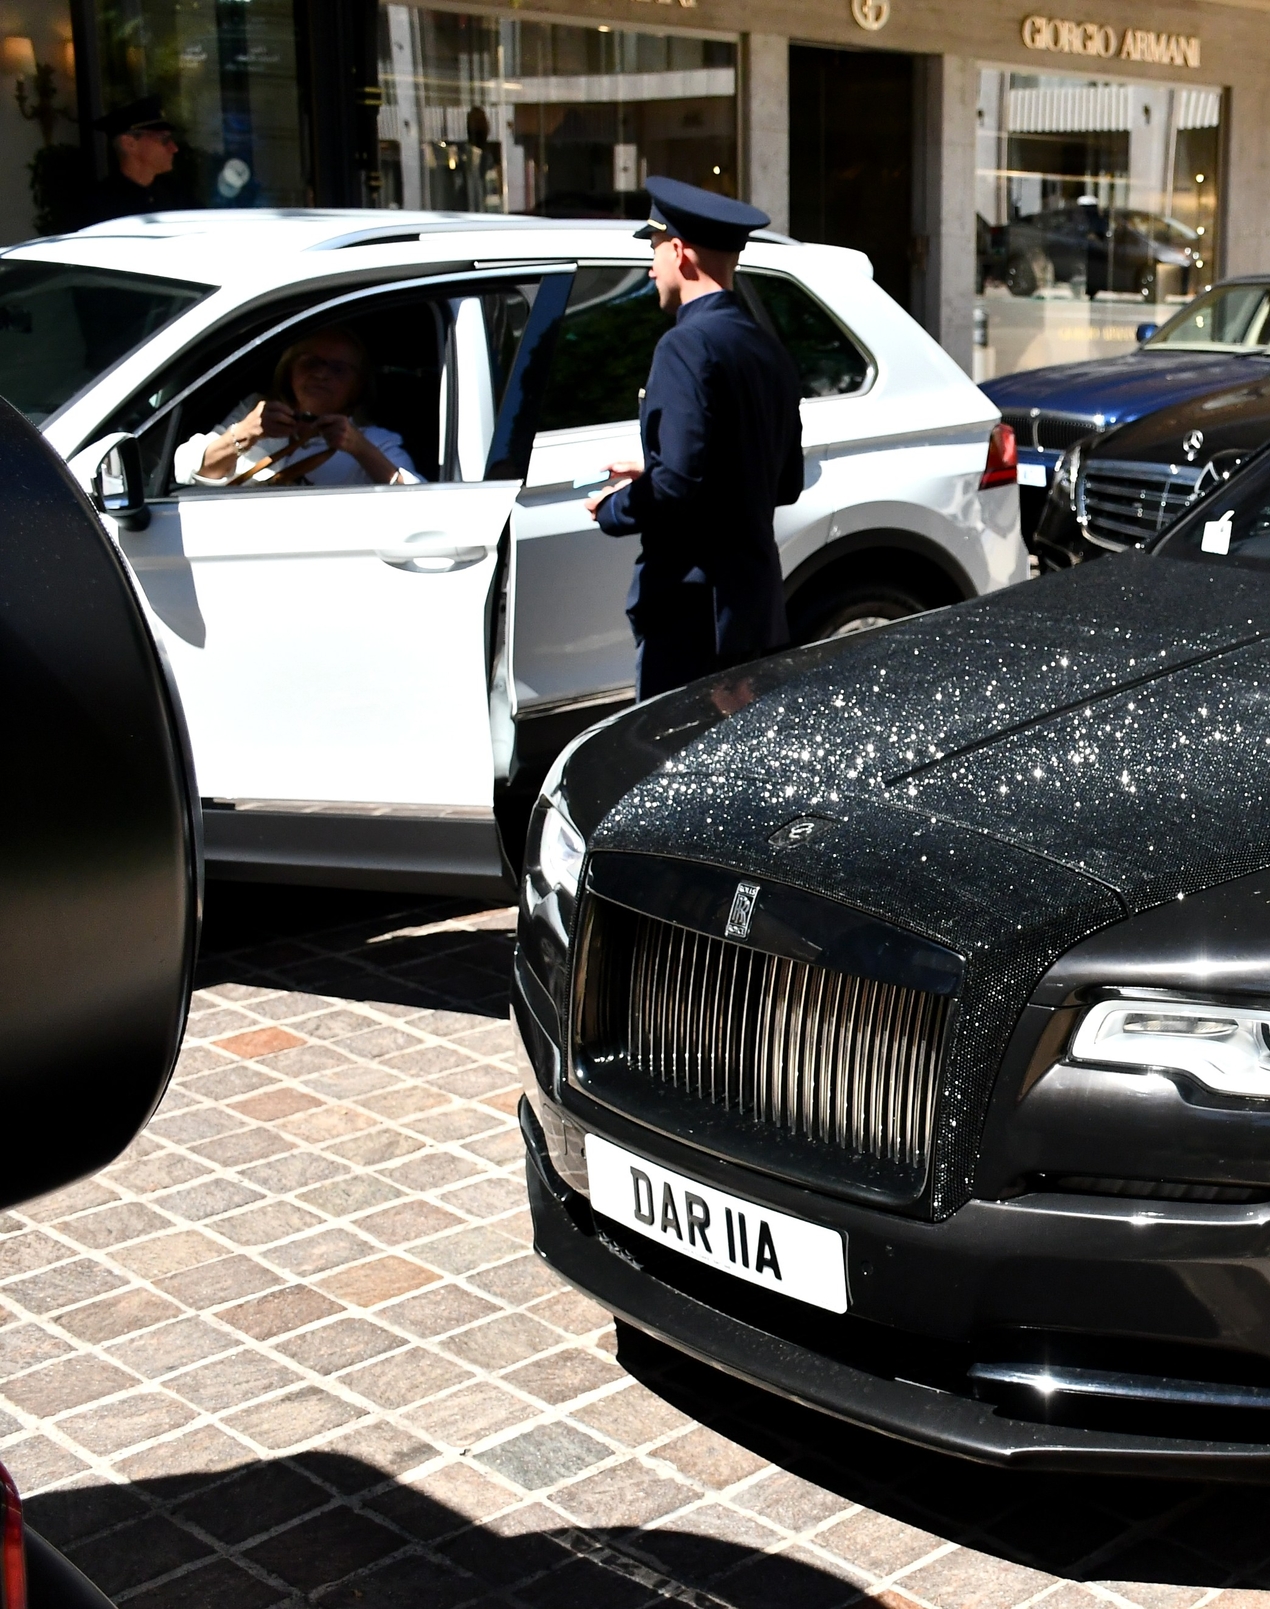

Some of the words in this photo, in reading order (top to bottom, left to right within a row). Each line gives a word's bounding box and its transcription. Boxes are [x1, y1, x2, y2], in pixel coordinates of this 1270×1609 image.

[1022, 15, 1118, 58] GIORGIO
[1119, 27, 1201, 68] ARMANI
[630, 1165, 712, 1255] DAR
